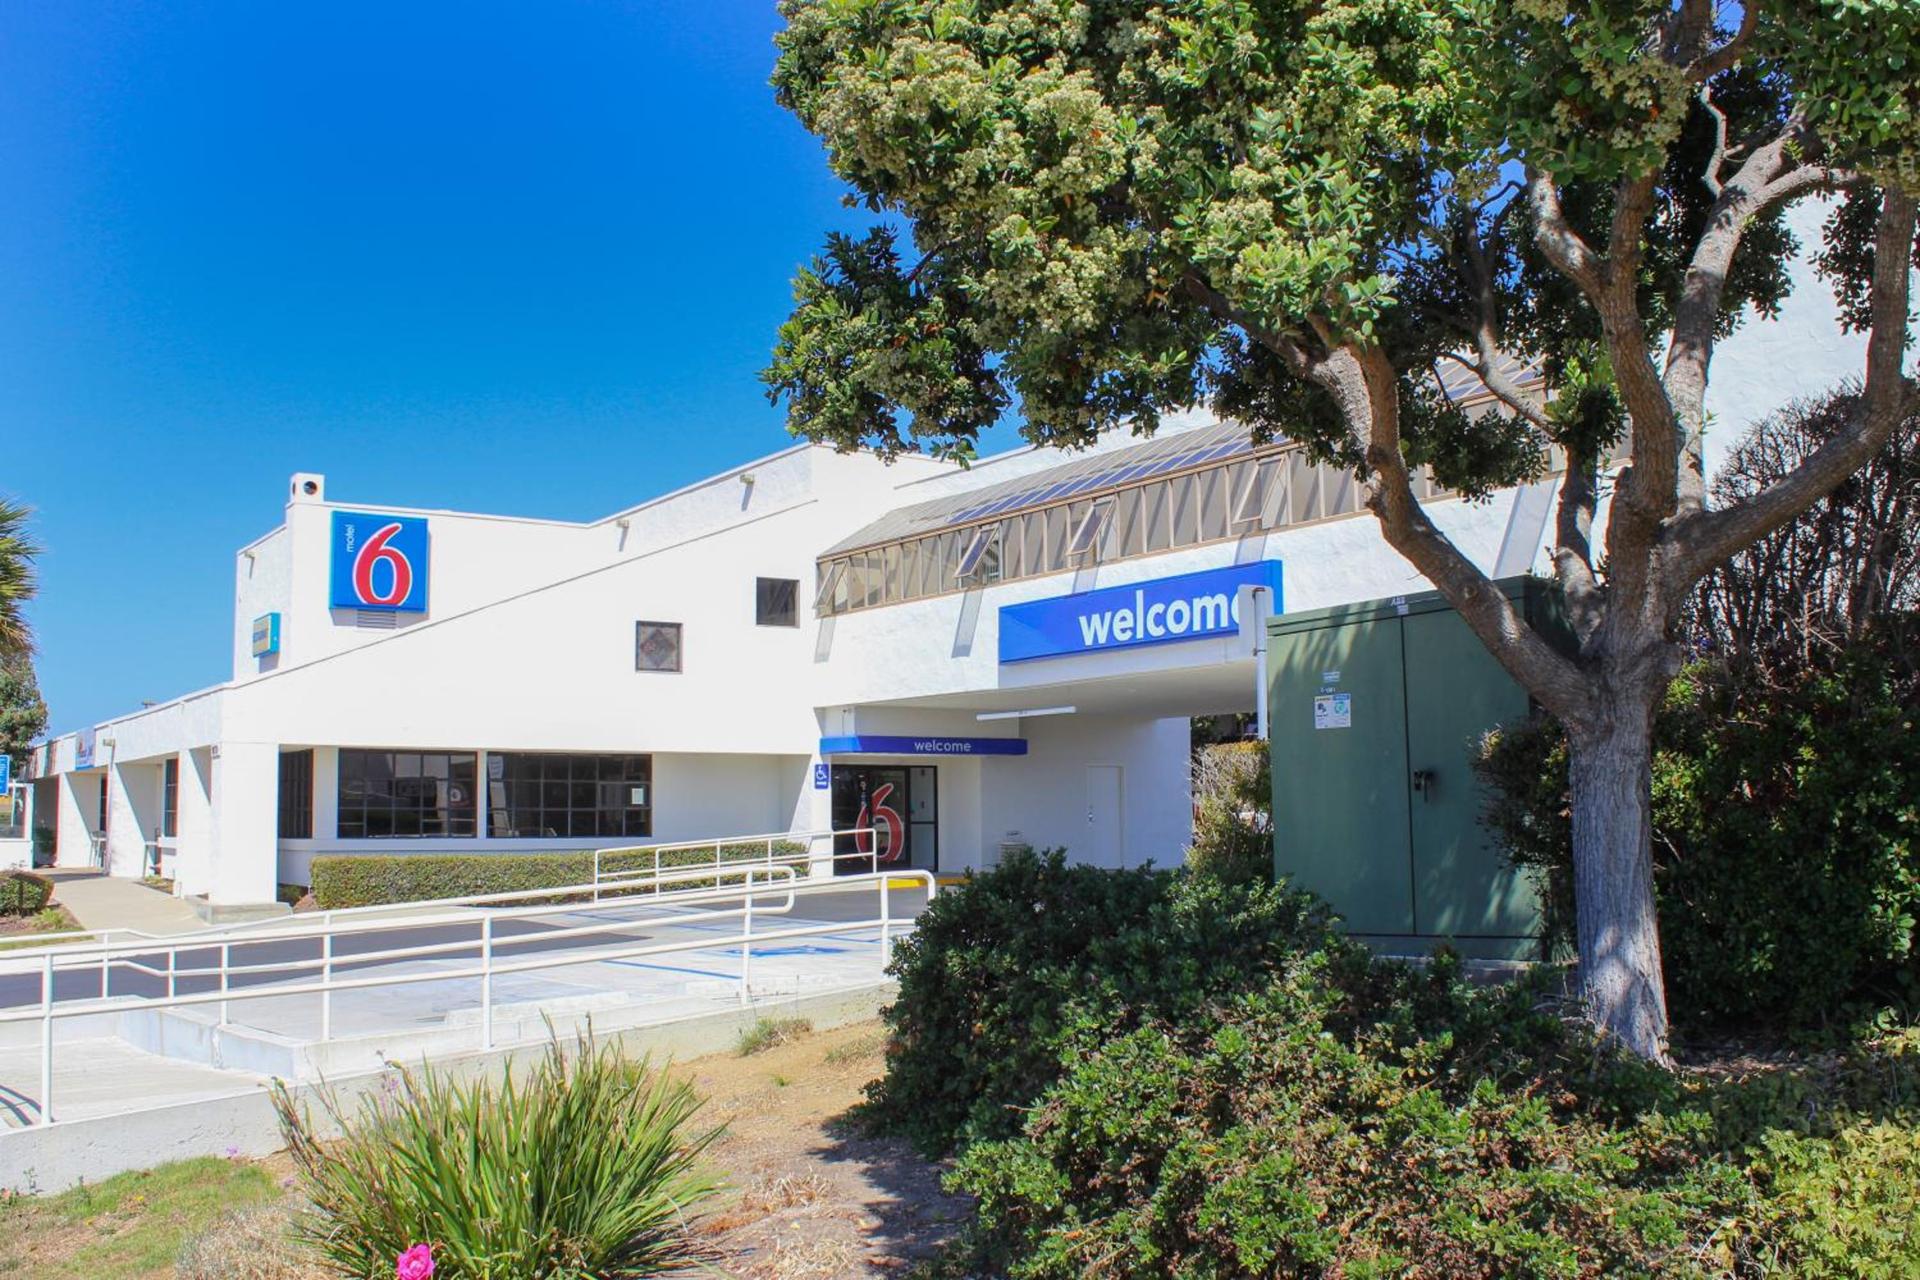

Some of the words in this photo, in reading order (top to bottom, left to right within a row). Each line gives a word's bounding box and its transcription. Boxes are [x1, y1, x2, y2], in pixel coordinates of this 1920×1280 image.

[344, 524, 355, 553] motel
[352, 522, 413, 606] 6
[914, 740, 972, 752] welcome
[855, 782, 904, 862] 6
